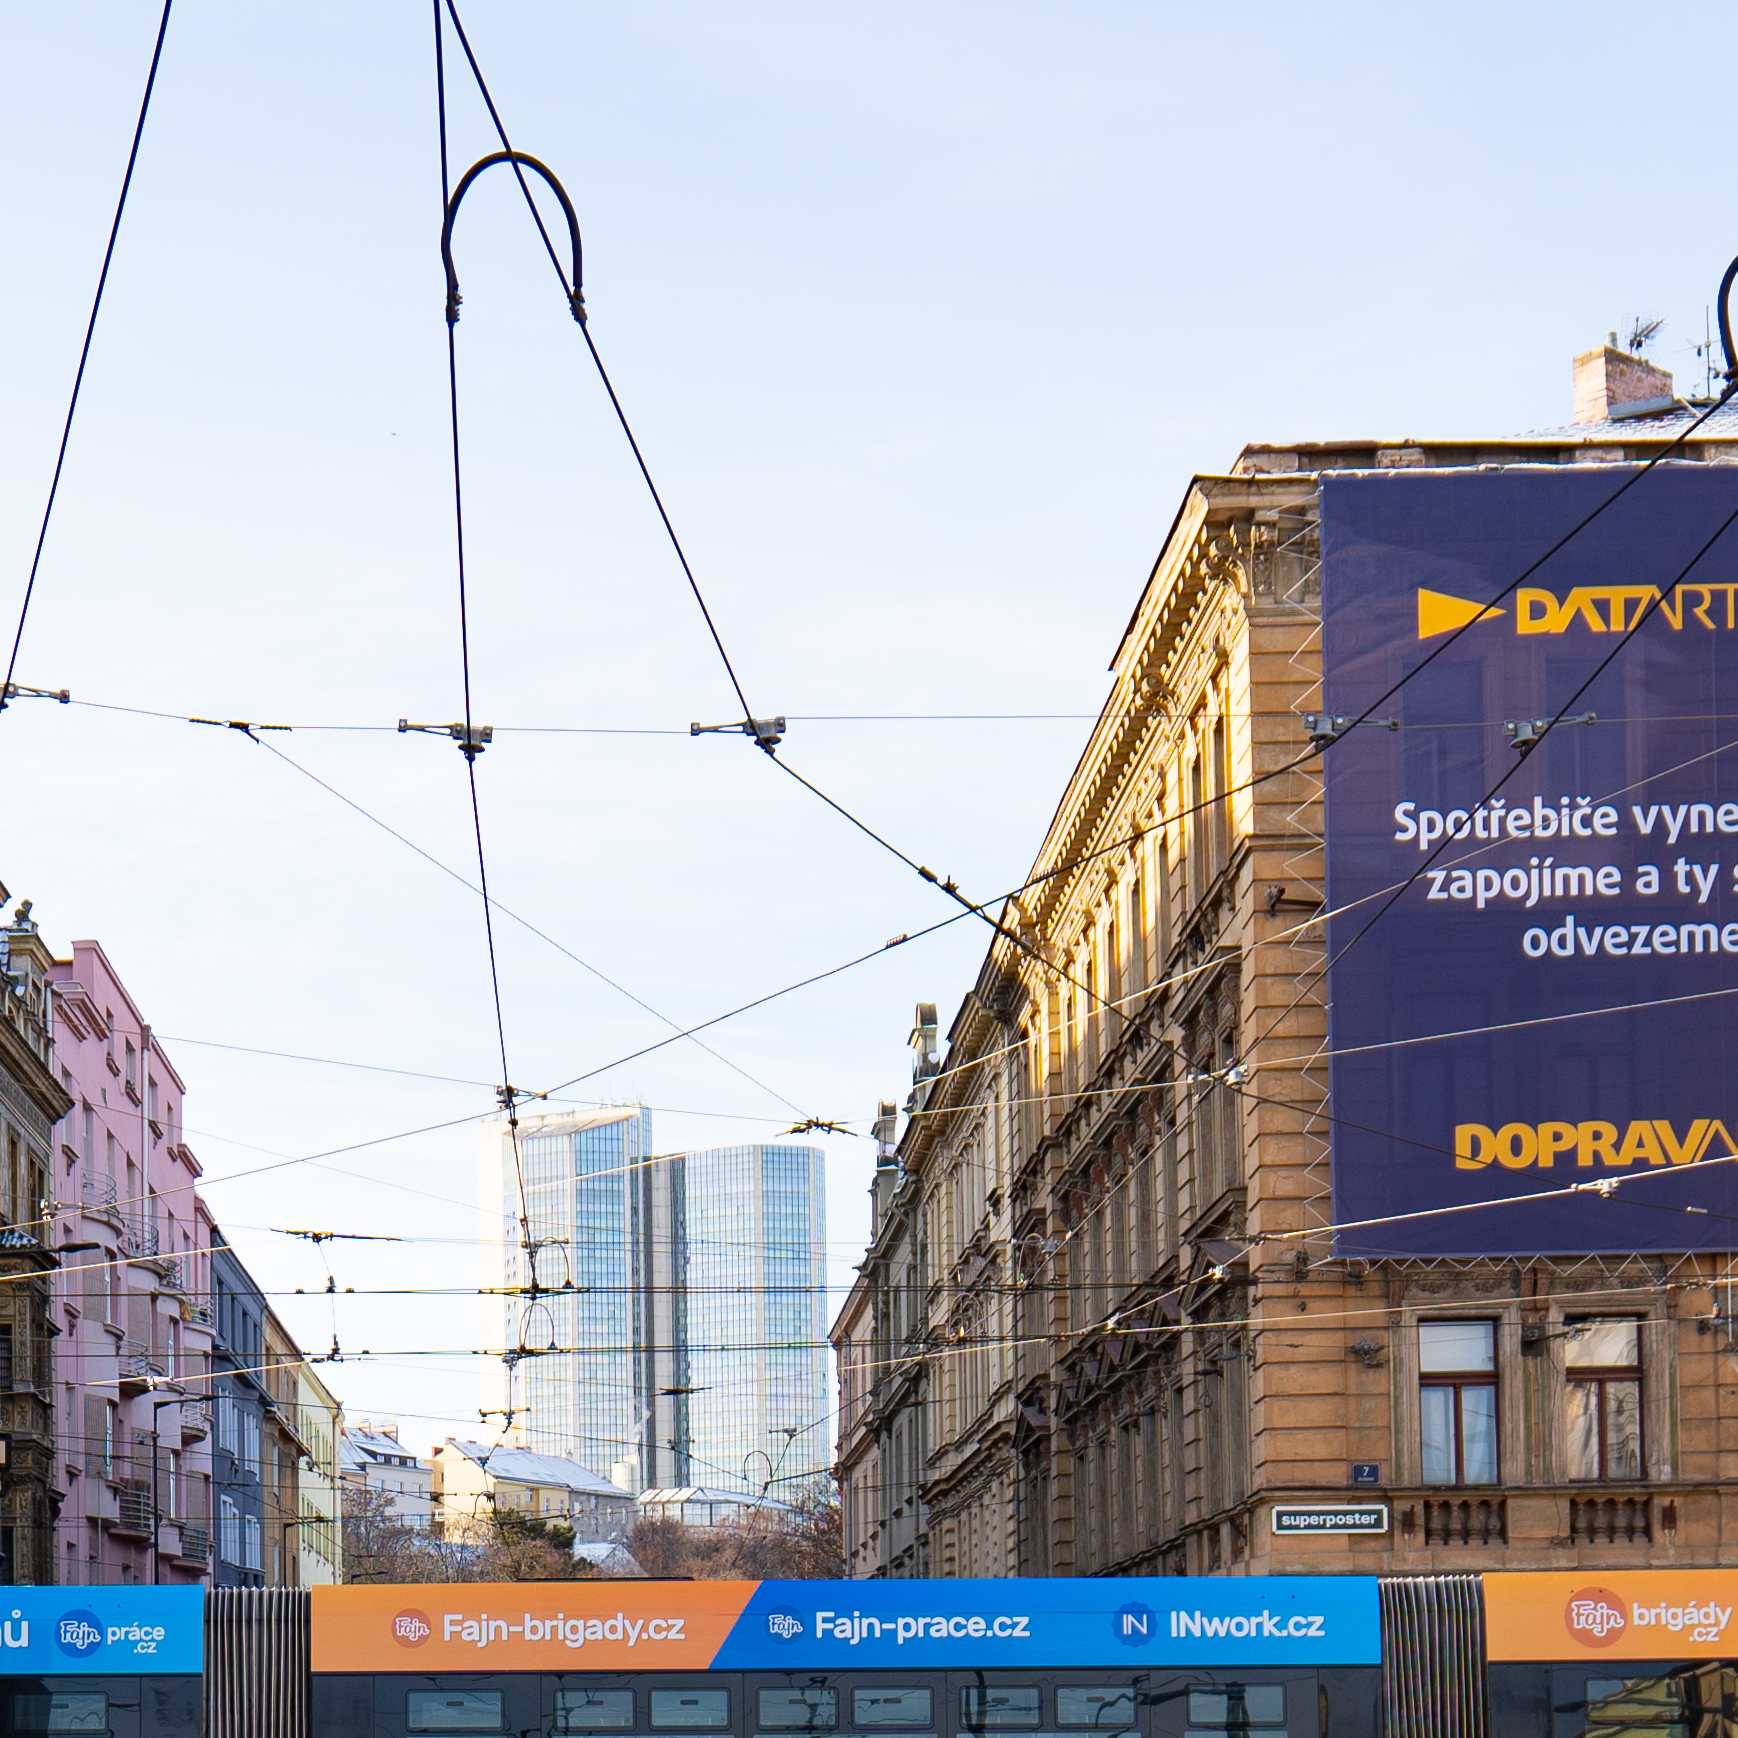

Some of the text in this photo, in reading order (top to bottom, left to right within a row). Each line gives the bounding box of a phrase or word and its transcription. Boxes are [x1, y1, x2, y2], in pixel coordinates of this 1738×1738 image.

[1393, 795, 1618, 850] Spotřebiče
[1426, 856, 1621, 908] zapojíme
[1635, 863, 1659, 894] a
[1674, 856, 1719, 903] ty
[1363, 1466, 1369, 1476] 7
[1281, 1512, 1378, 1528] superposter
[395, 1616, 430, 1641] Fajn
[443, 1613, 685, 1648] Fajn-brigady.cz
[768, 1614, 803, 1638] Fajn
[815, 1611, 1031, 1645] Fajn-prace.cz
[1122, 1614, 1147, 1635] IN
[1170, 1610, 1326, 1637] INwork.cz
[1571, 1600, 1733, 1637] Fajn brigády
[60, 1620, 165, 1649] Fajn práce
[1688, 1626, 1720, 1641] .cz
[133, 1641, 157, 1654] .cz
